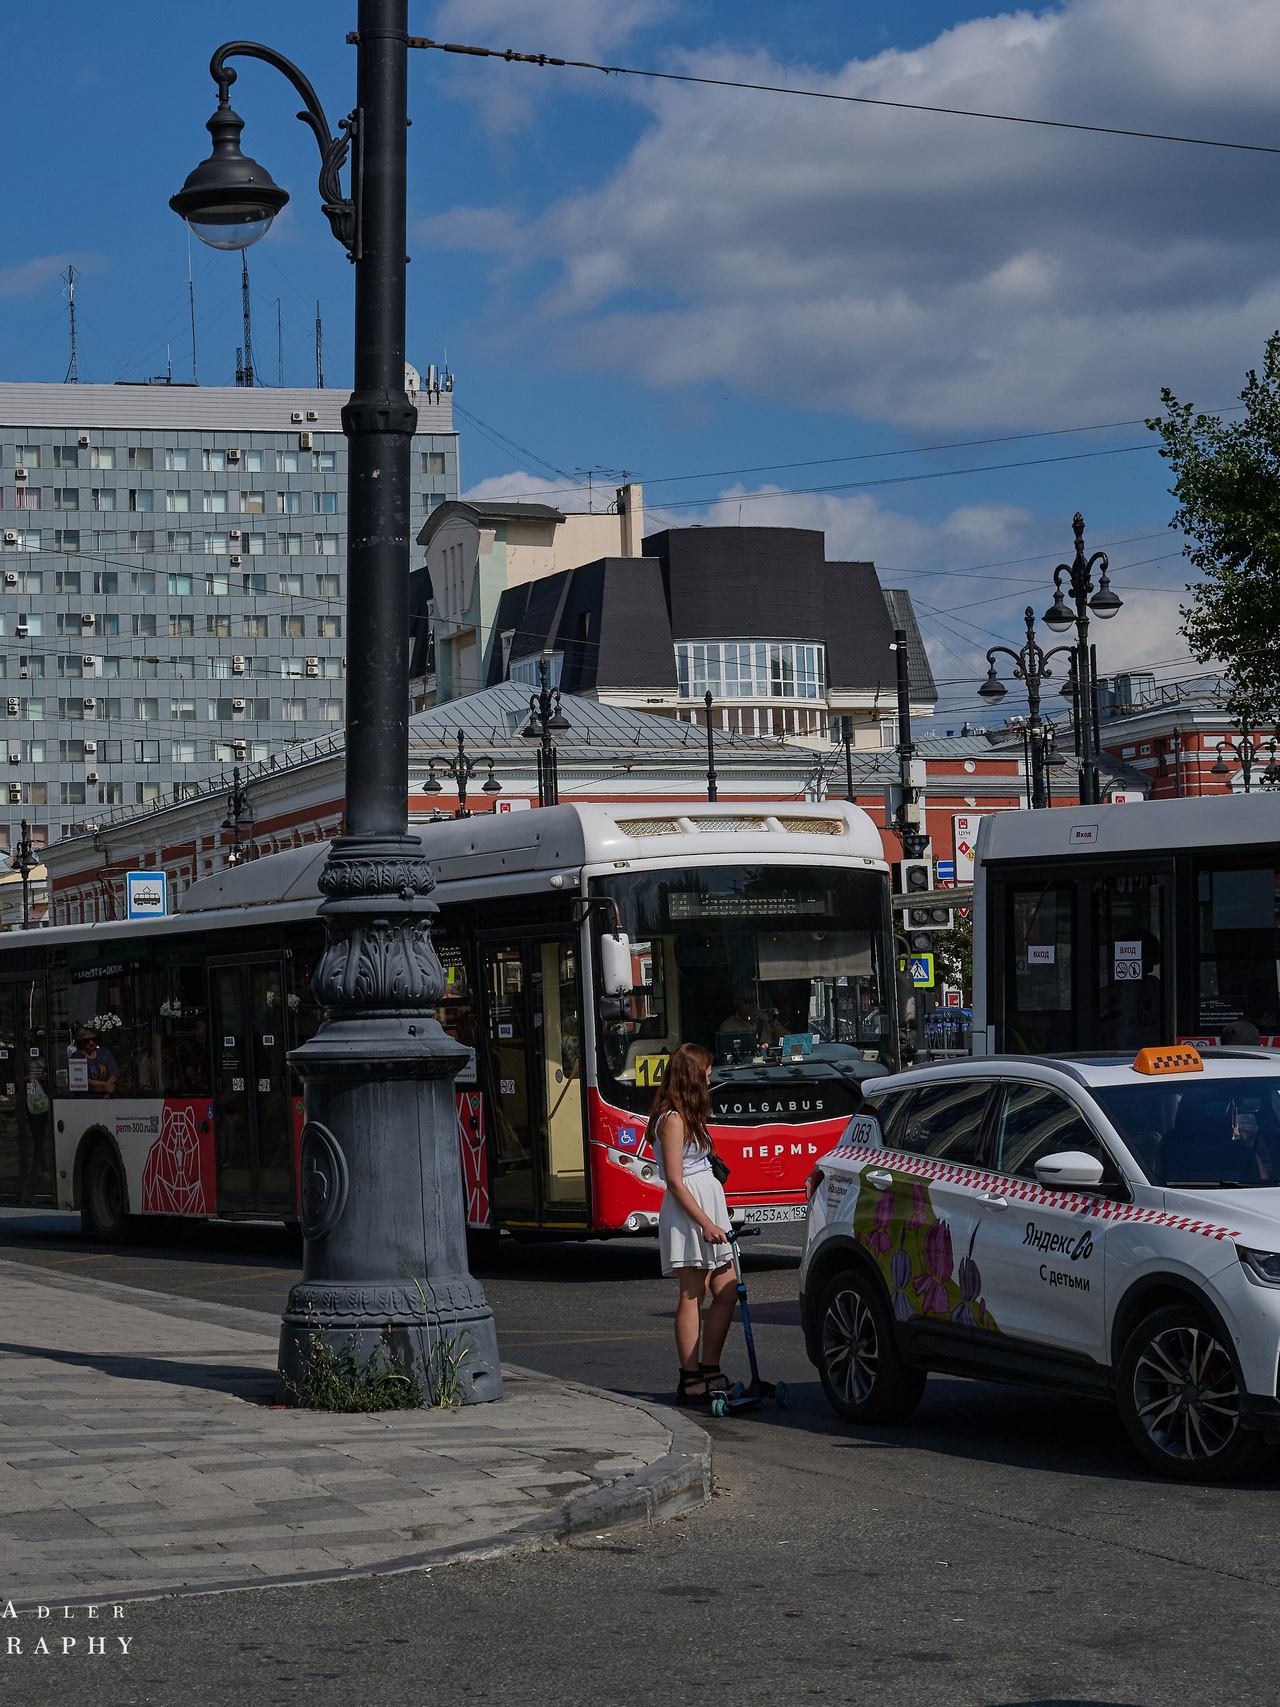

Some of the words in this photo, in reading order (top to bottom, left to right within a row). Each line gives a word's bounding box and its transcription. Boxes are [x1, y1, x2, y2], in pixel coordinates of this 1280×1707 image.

[720, 1100, 823, 1113] VOLGABUS
[116, 1122, 151, 1134] perm-300.ru
[851, 1123, 872, 1143] 063
[743, 1143, 817, 1158] ПЕРМЬ
[1039, 1264, 1048, 1282] С
[1049, 1270, 1090, 1292] детьми
